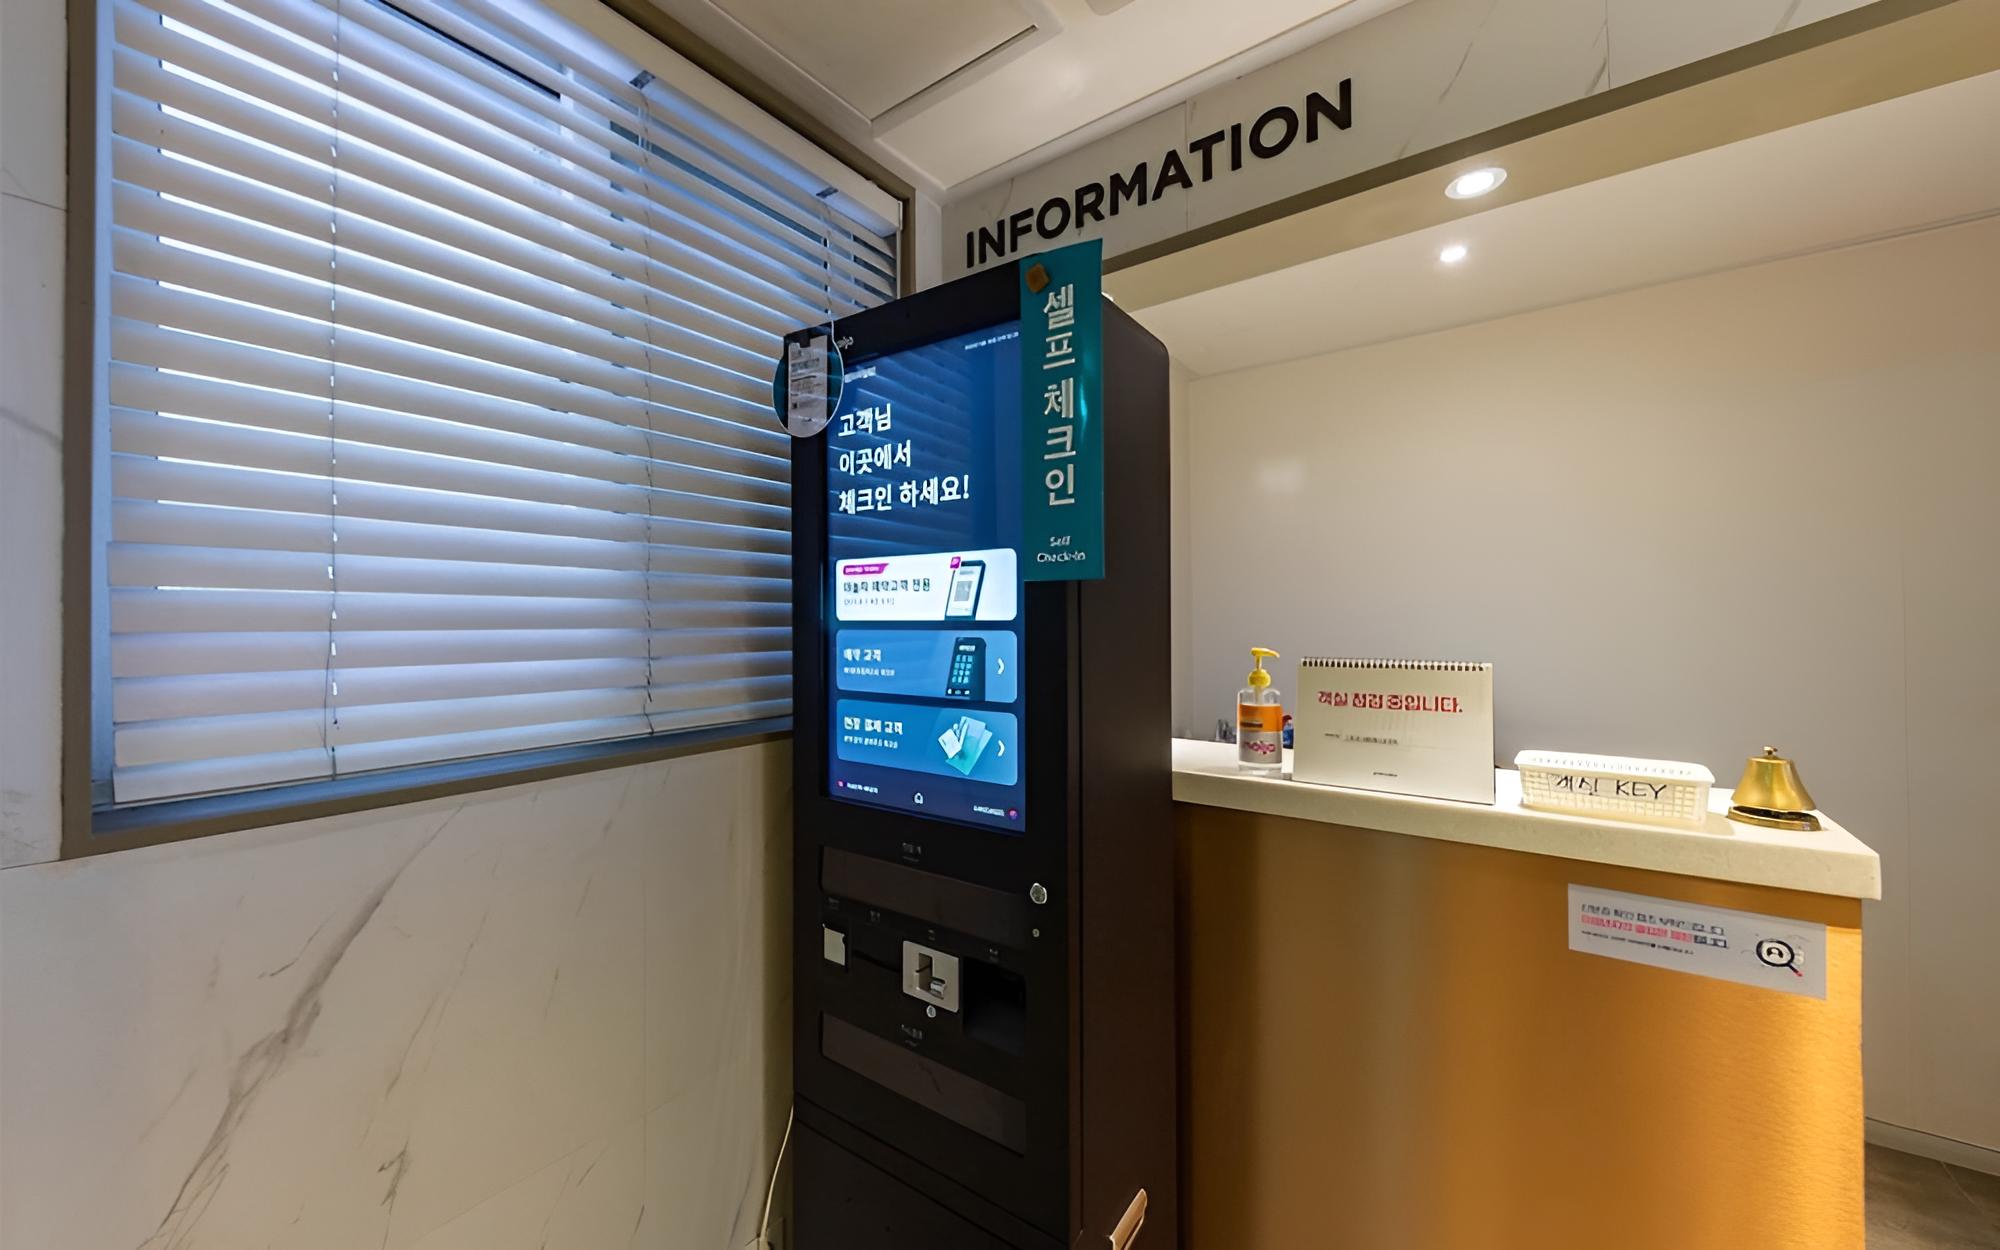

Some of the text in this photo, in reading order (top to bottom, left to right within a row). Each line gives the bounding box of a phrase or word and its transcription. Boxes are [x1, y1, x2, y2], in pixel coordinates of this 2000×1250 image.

[966, 77, 1352, 268] INFORMATION
[838, 403, 892, 437] 고객님
[839, 439, 911, 476] 이곳에서
[839, 474, 969, 515] 체크인 하세요!
[1616, 779, 1667, 800] KEY
